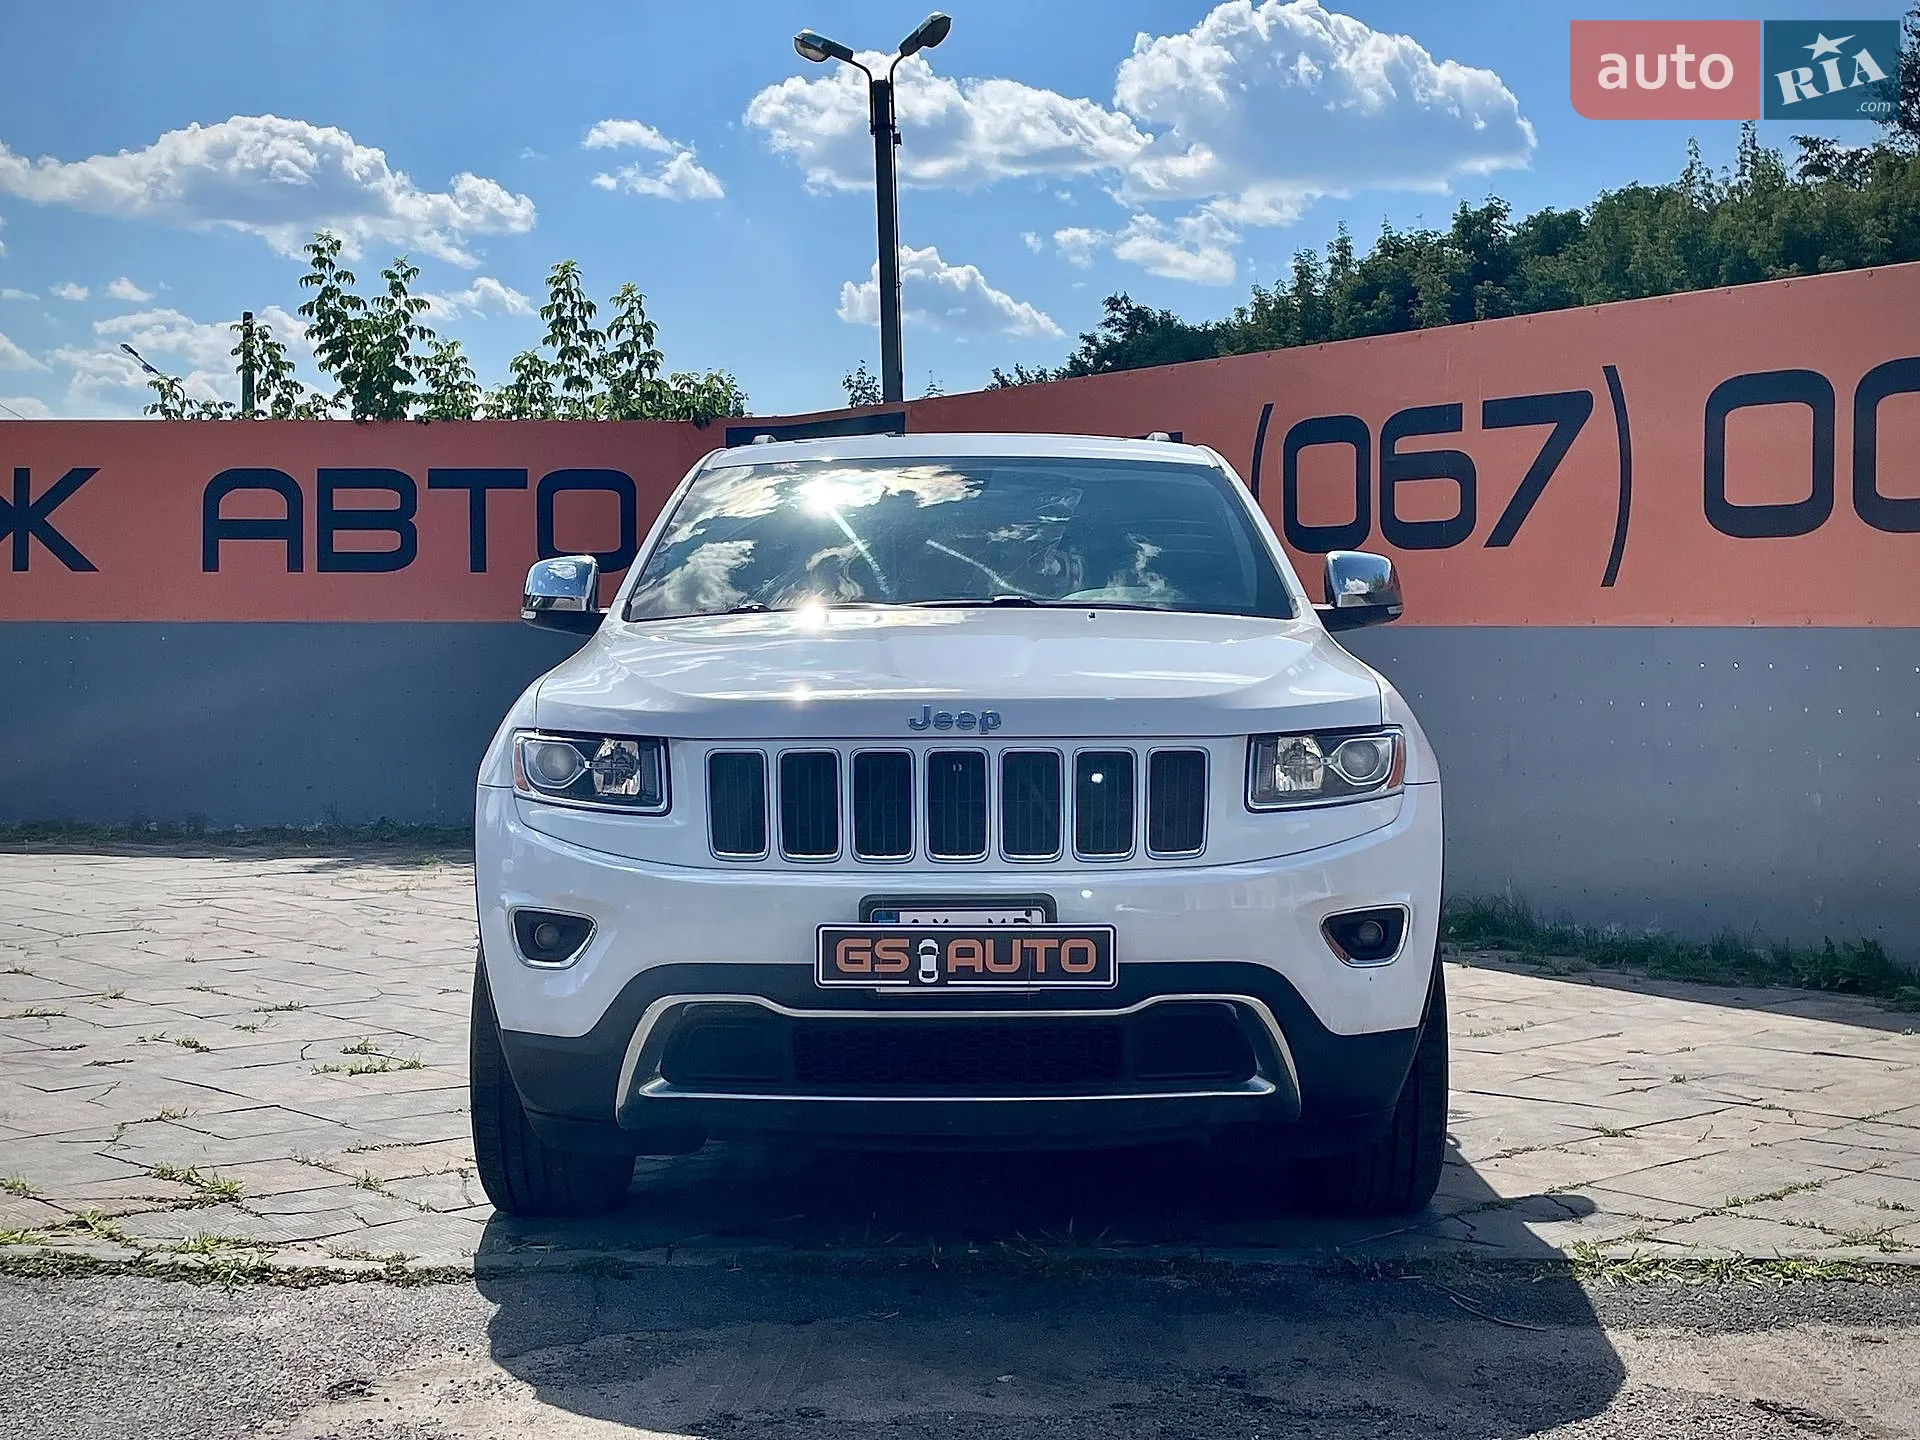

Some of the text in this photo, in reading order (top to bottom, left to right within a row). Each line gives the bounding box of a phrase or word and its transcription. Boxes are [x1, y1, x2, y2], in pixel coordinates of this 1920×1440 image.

[1251, 365, 1632, 587] (067)
[202, 467, 638, 573] АВТО
[908, 704, 1002, 735] Jeep
[836, 938, 1097, 973] GS AUTO
